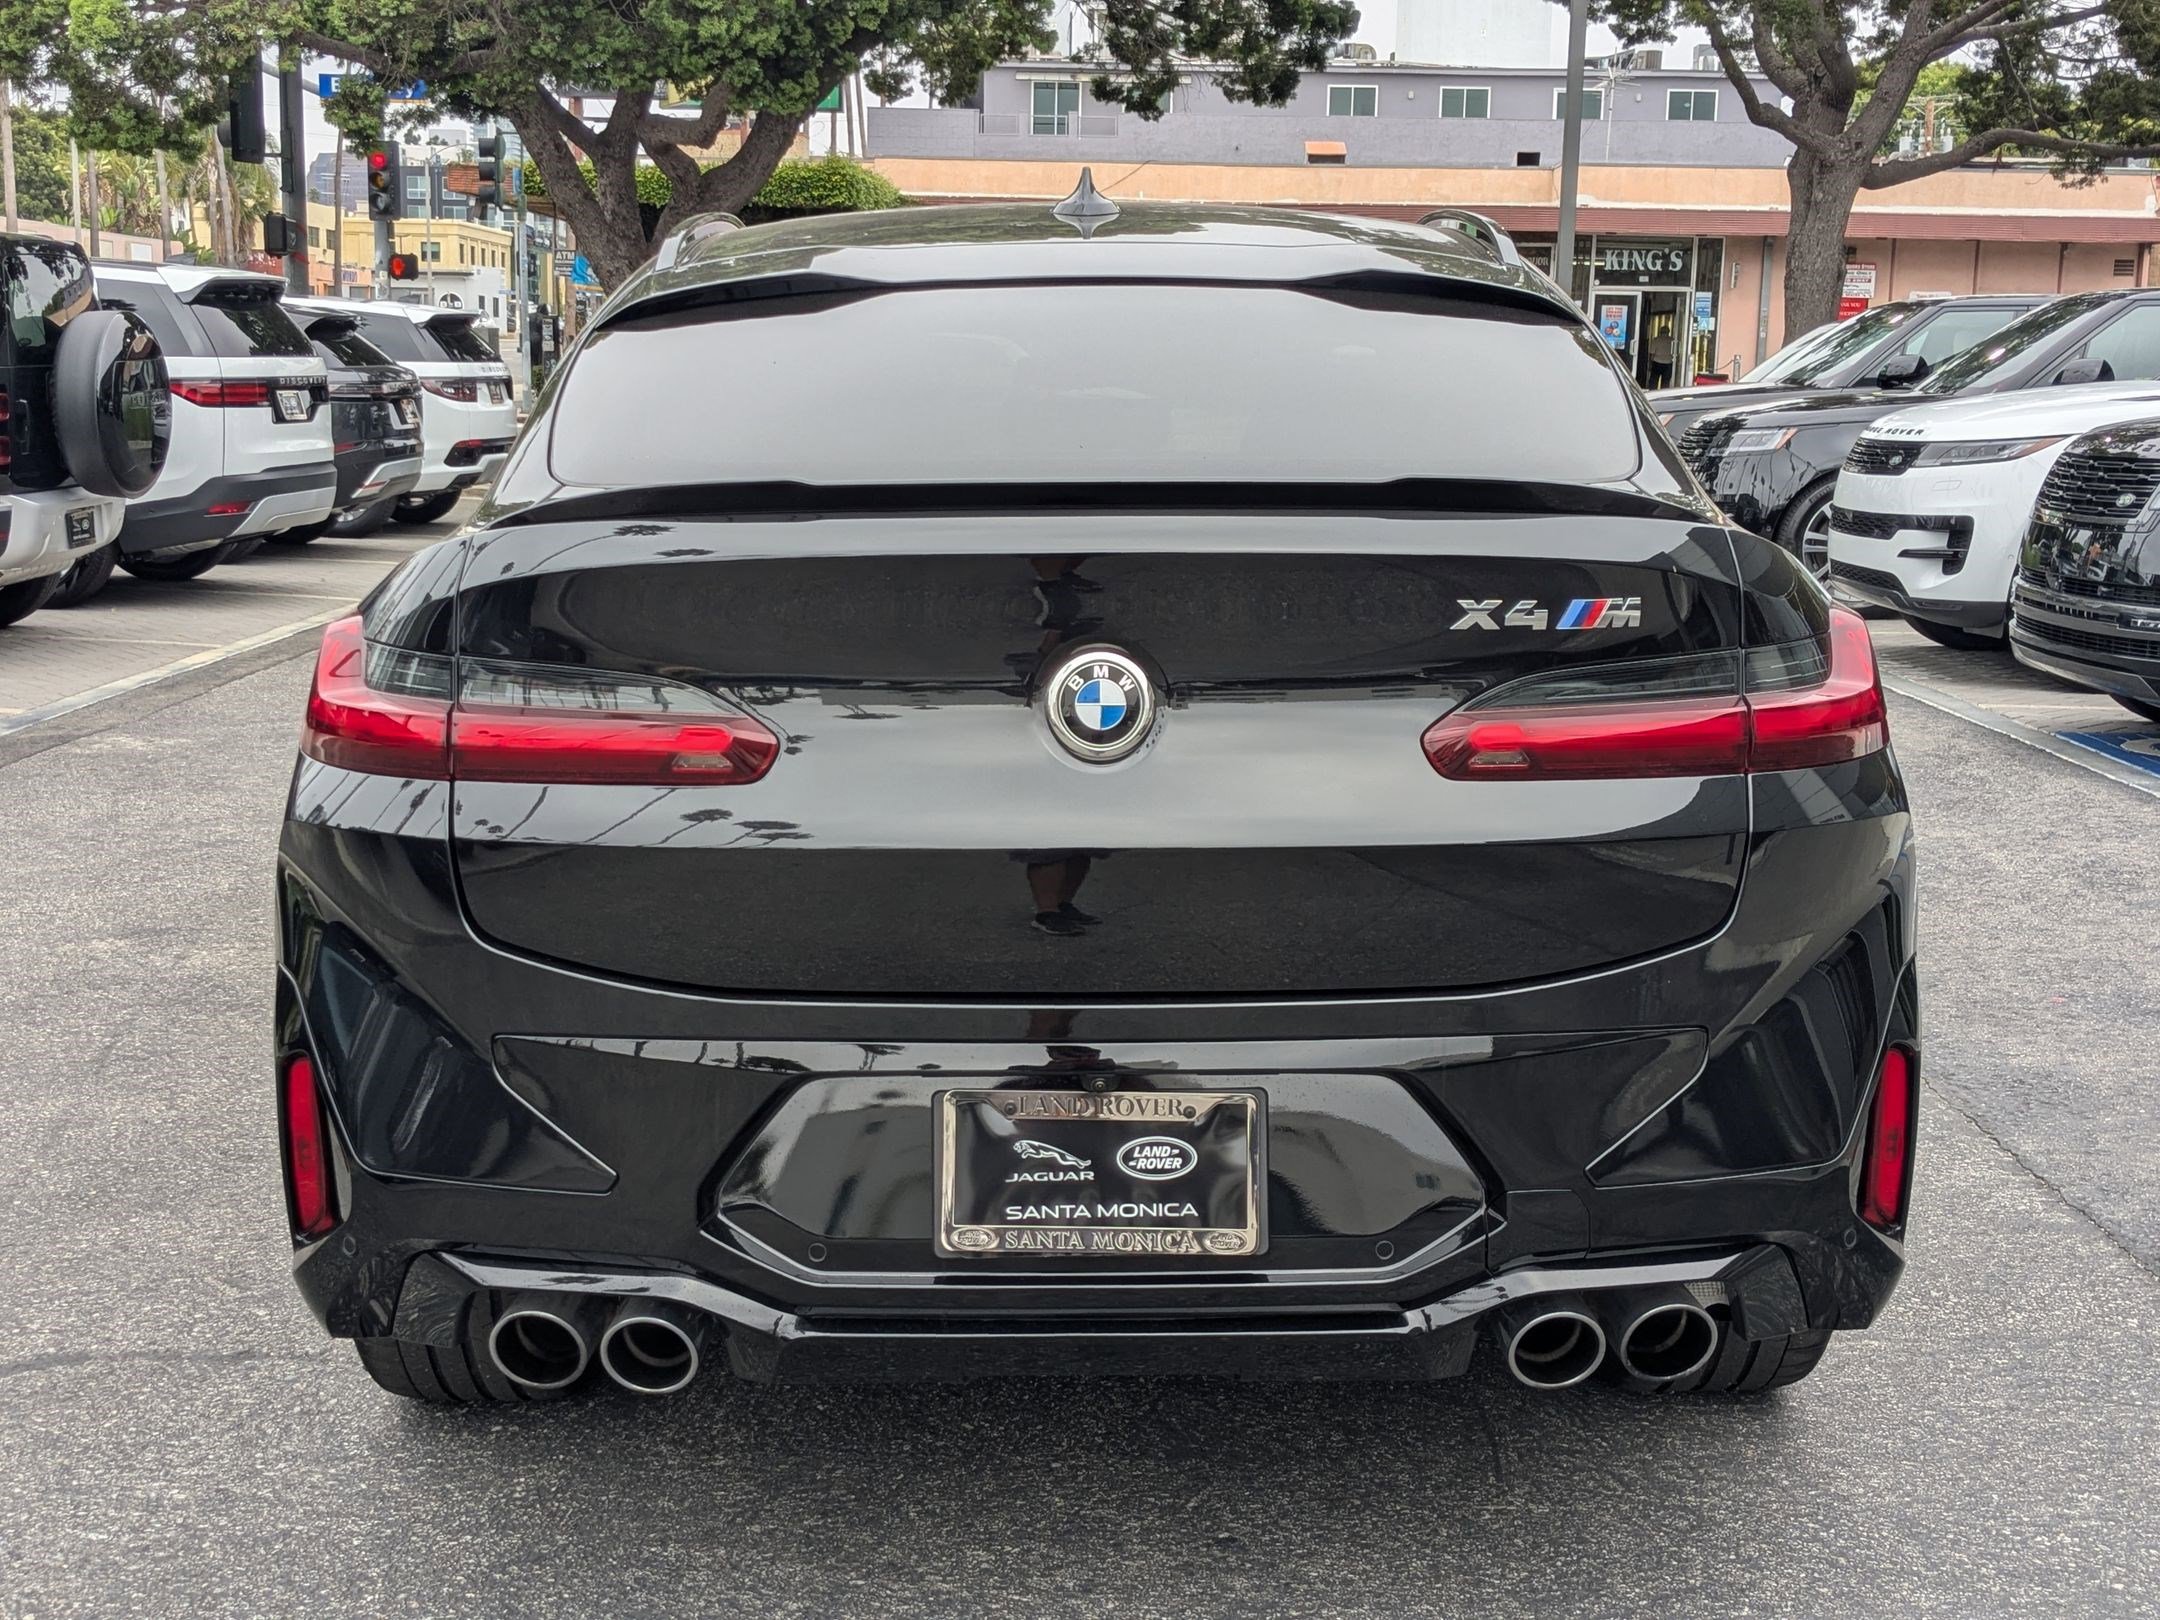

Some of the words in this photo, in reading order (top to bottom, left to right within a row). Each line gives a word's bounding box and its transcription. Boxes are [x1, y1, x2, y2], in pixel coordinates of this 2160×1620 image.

[555, 251, 575, 260] ATM
[1604, 248, 1684, 271] KING'S
[1449, 599, 1548, 630] X4
[1067, 665, 1135, 692] BMW
[1017, 1096, 1089, 1118] LAND
[1097, 1095, 1184, 1118] ROVER
[1132, 1145, 1171, 1158] LAND
[1136, 1156, 1183, 1170] ROVER
[1005, 1171, 1095, 1183] JAGUAR
[1006, 1203, 1092, 1220] SANTA
[1097, 1202, 1199, 1218] MONICA
[1005, 1229, 1085, 1250] SANTA
[1091, 1230, 1201, 1252] MONICA
